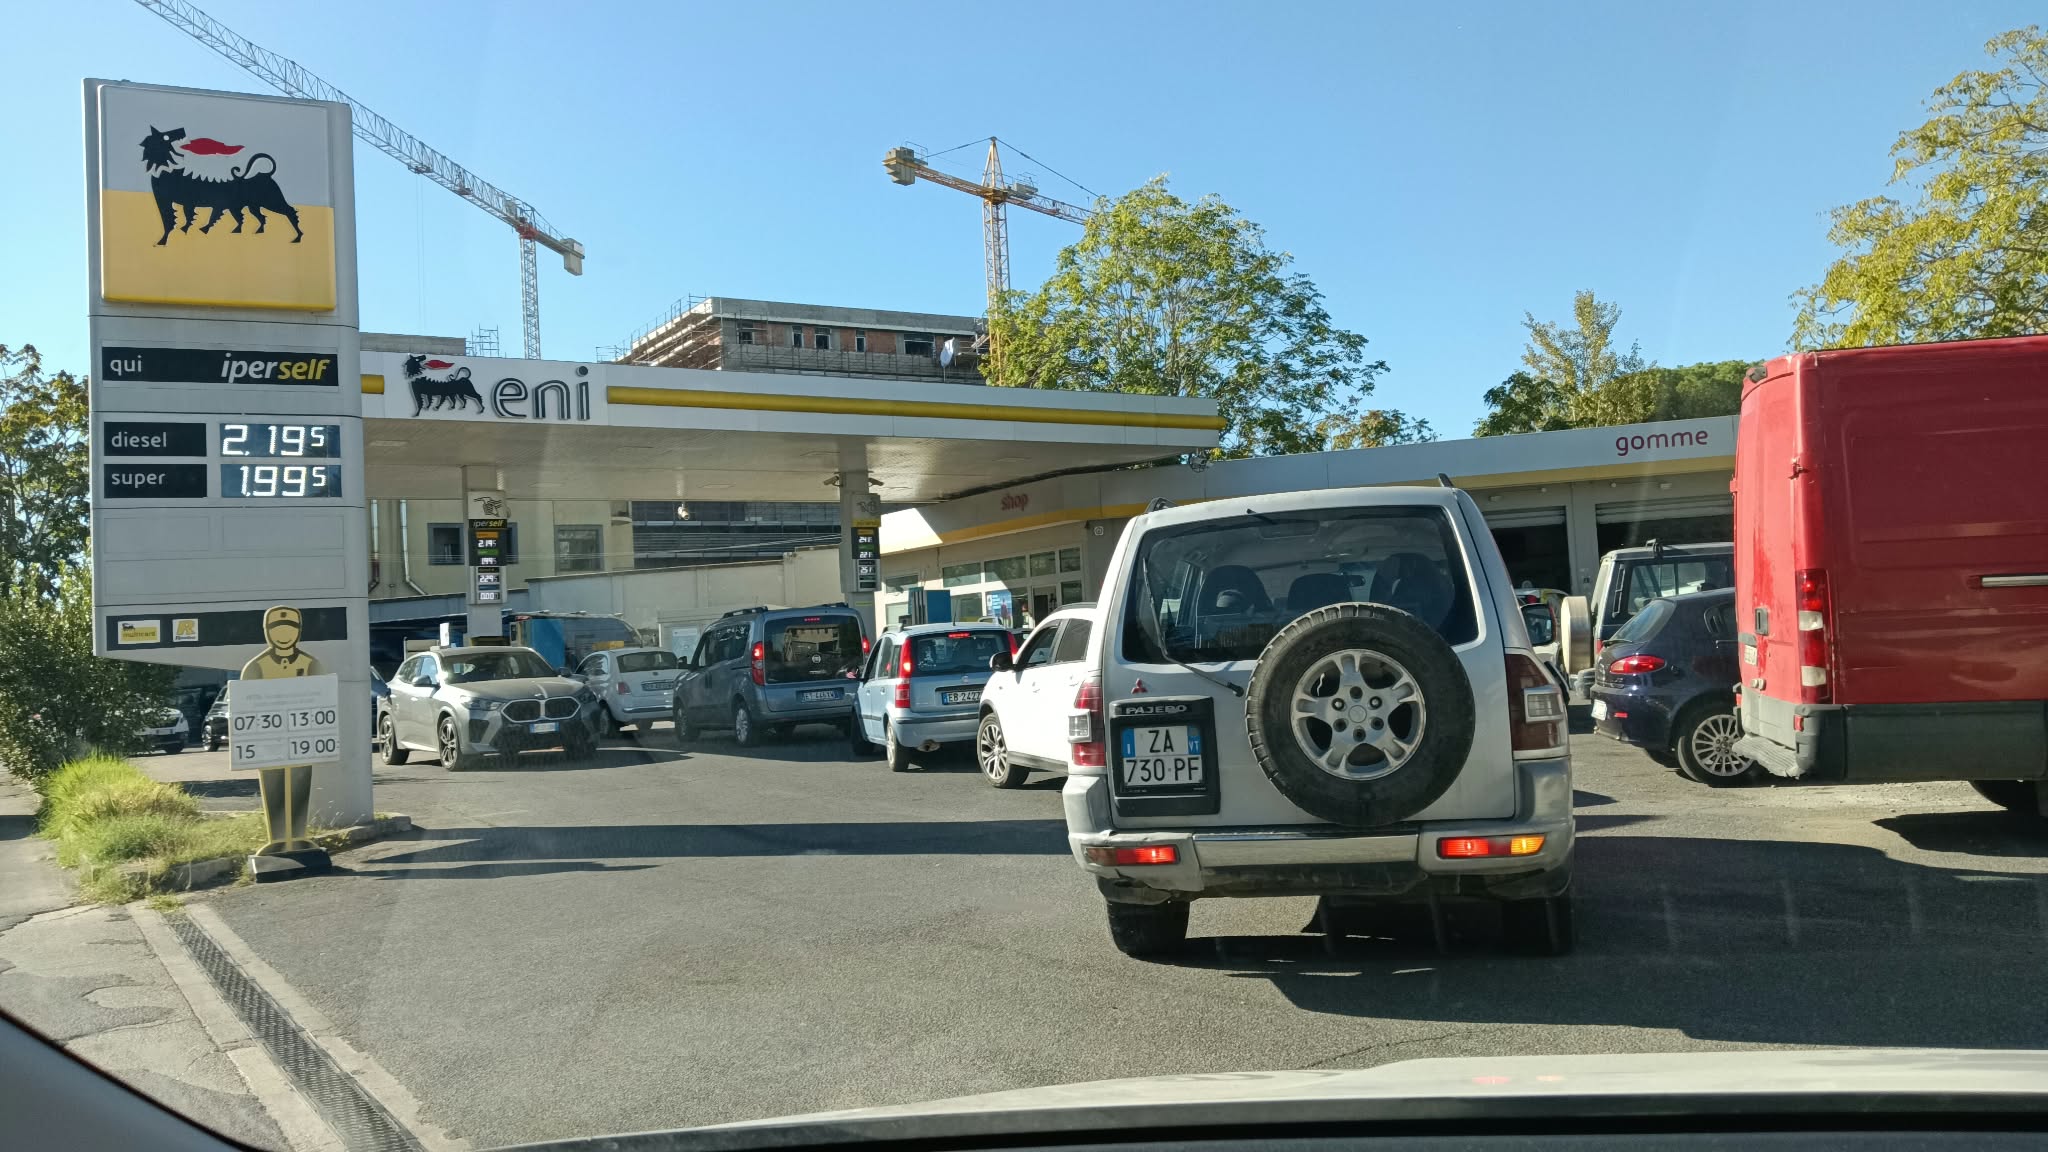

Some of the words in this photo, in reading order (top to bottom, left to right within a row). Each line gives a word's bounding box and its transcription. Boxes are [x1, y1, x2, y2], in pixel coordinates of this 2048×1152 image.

[110, 356, 142, 375] qui
[221, 353, 330, 383] iperself
[492, 366, 590, 421] eni
[111, 432, 167, 448] diesel
[1615, 430, 1708, 457] gomme
[111, 472, 165, 489] super
[1001, 494, 1029, 512] shop
[1126, 704, 1187, 714] PAJERO
[234, 714, 282, 731] 07:30
[289, 709, 336, 727] 13:00
[1148, 729, 1175, 754] ZA
[235, 744, 256, 760] 15
[1126, 759, 1165, 782] 730
[1174, 757, 1199, 781] PF
